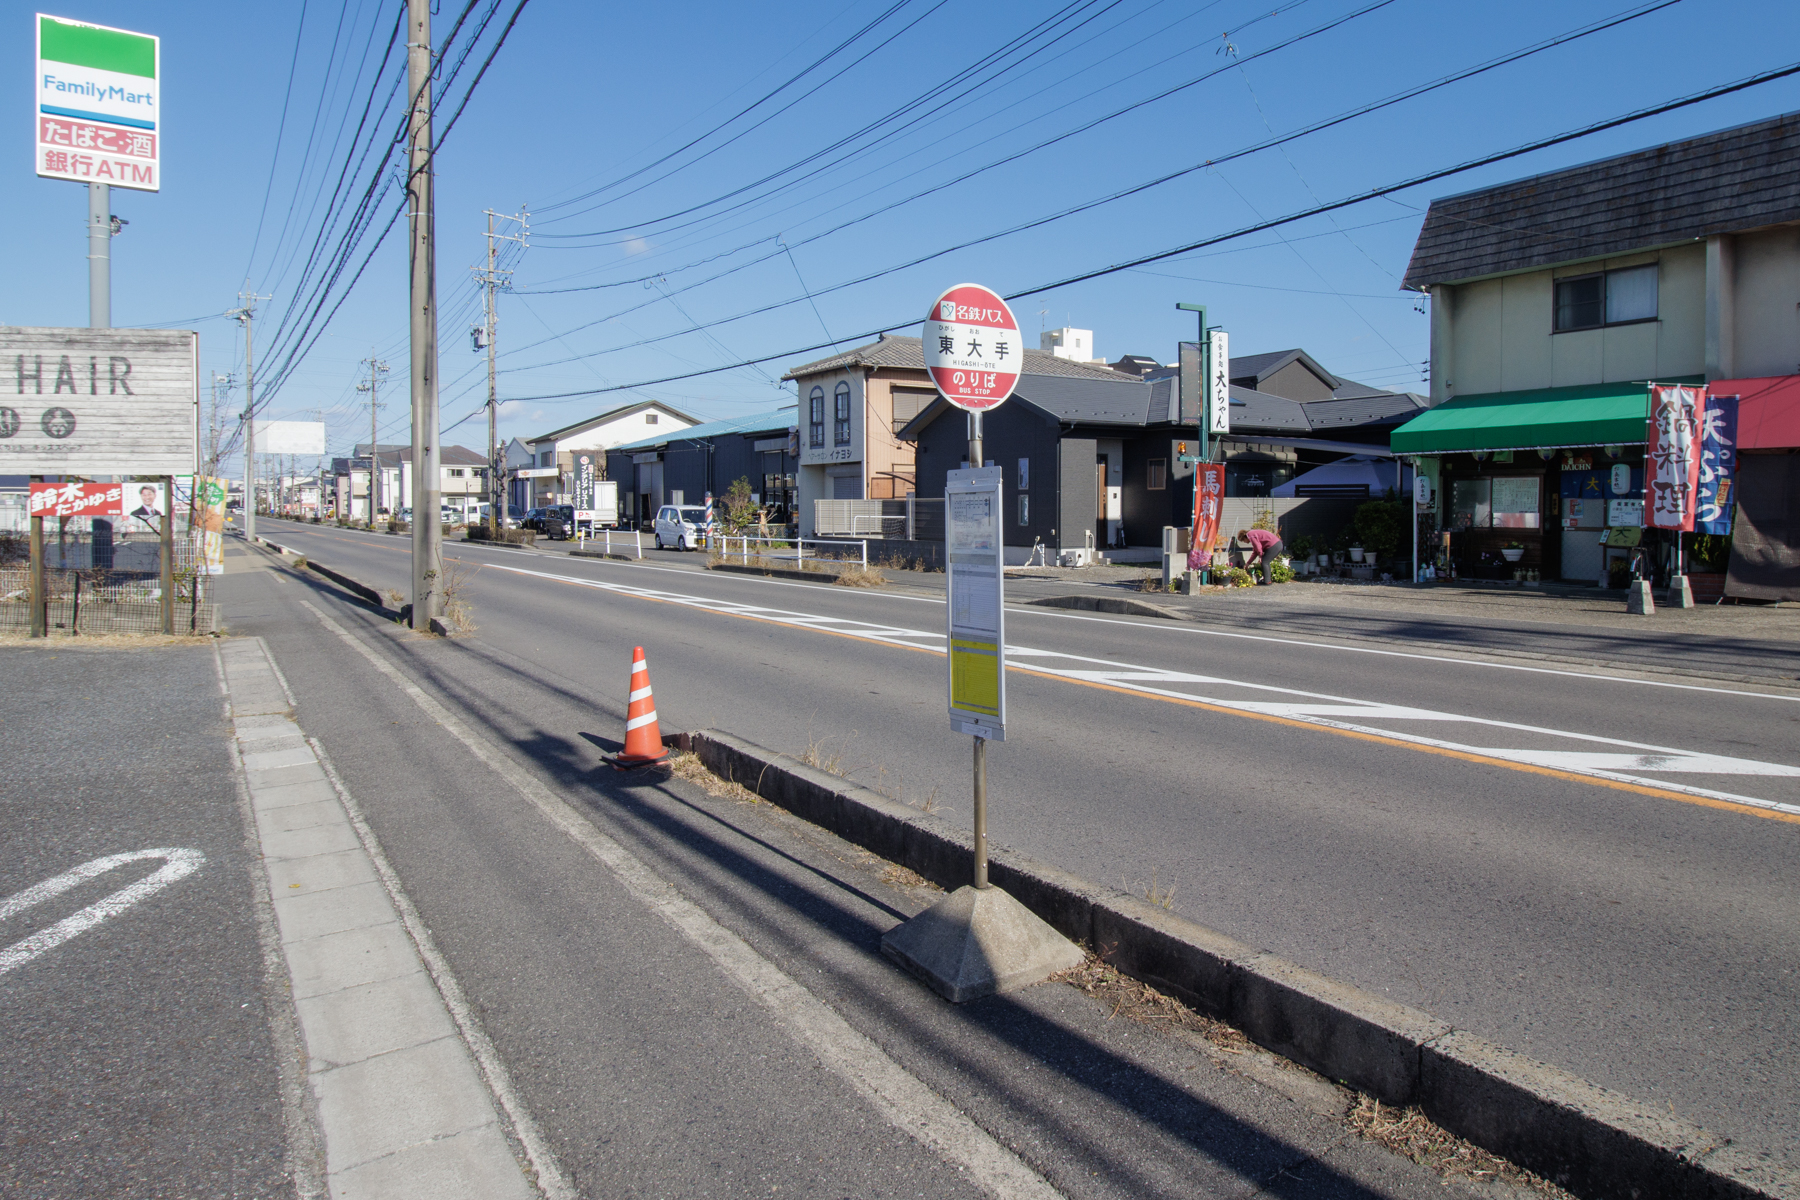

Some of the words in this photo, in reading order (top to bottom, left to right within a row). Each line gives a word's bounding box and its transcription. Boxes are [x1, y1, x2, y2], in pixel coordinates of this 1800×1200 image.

[44, 74, 153, 106] FamilyMart
[45, 121, 152, 158] たばこ・酒
[45, 150, 153, 184] 銀行ATM
[956, 305, 1004, 324] 名鉄バス
[938, 335, 1010, 361] 東大手
[17, 354, 135, 396] HAIR
[952, 371, 997, 389] のりば
[1215, 370, 1227, 429] 大ちゃん
[830, 449, 853, 460] イナヨシ
[1651, 400, 1697, 515] 鍋料理
[1695, 408, 1733, 522] 天ぷら
[31, 483, 84, 513] 鈴木
[55, 488, 121, 516] たかゆき
[1200, 470, 1220, 542] 馬刺し
[578, 511, 584, 519] P
[1613, 527, 1632, 539] 大
